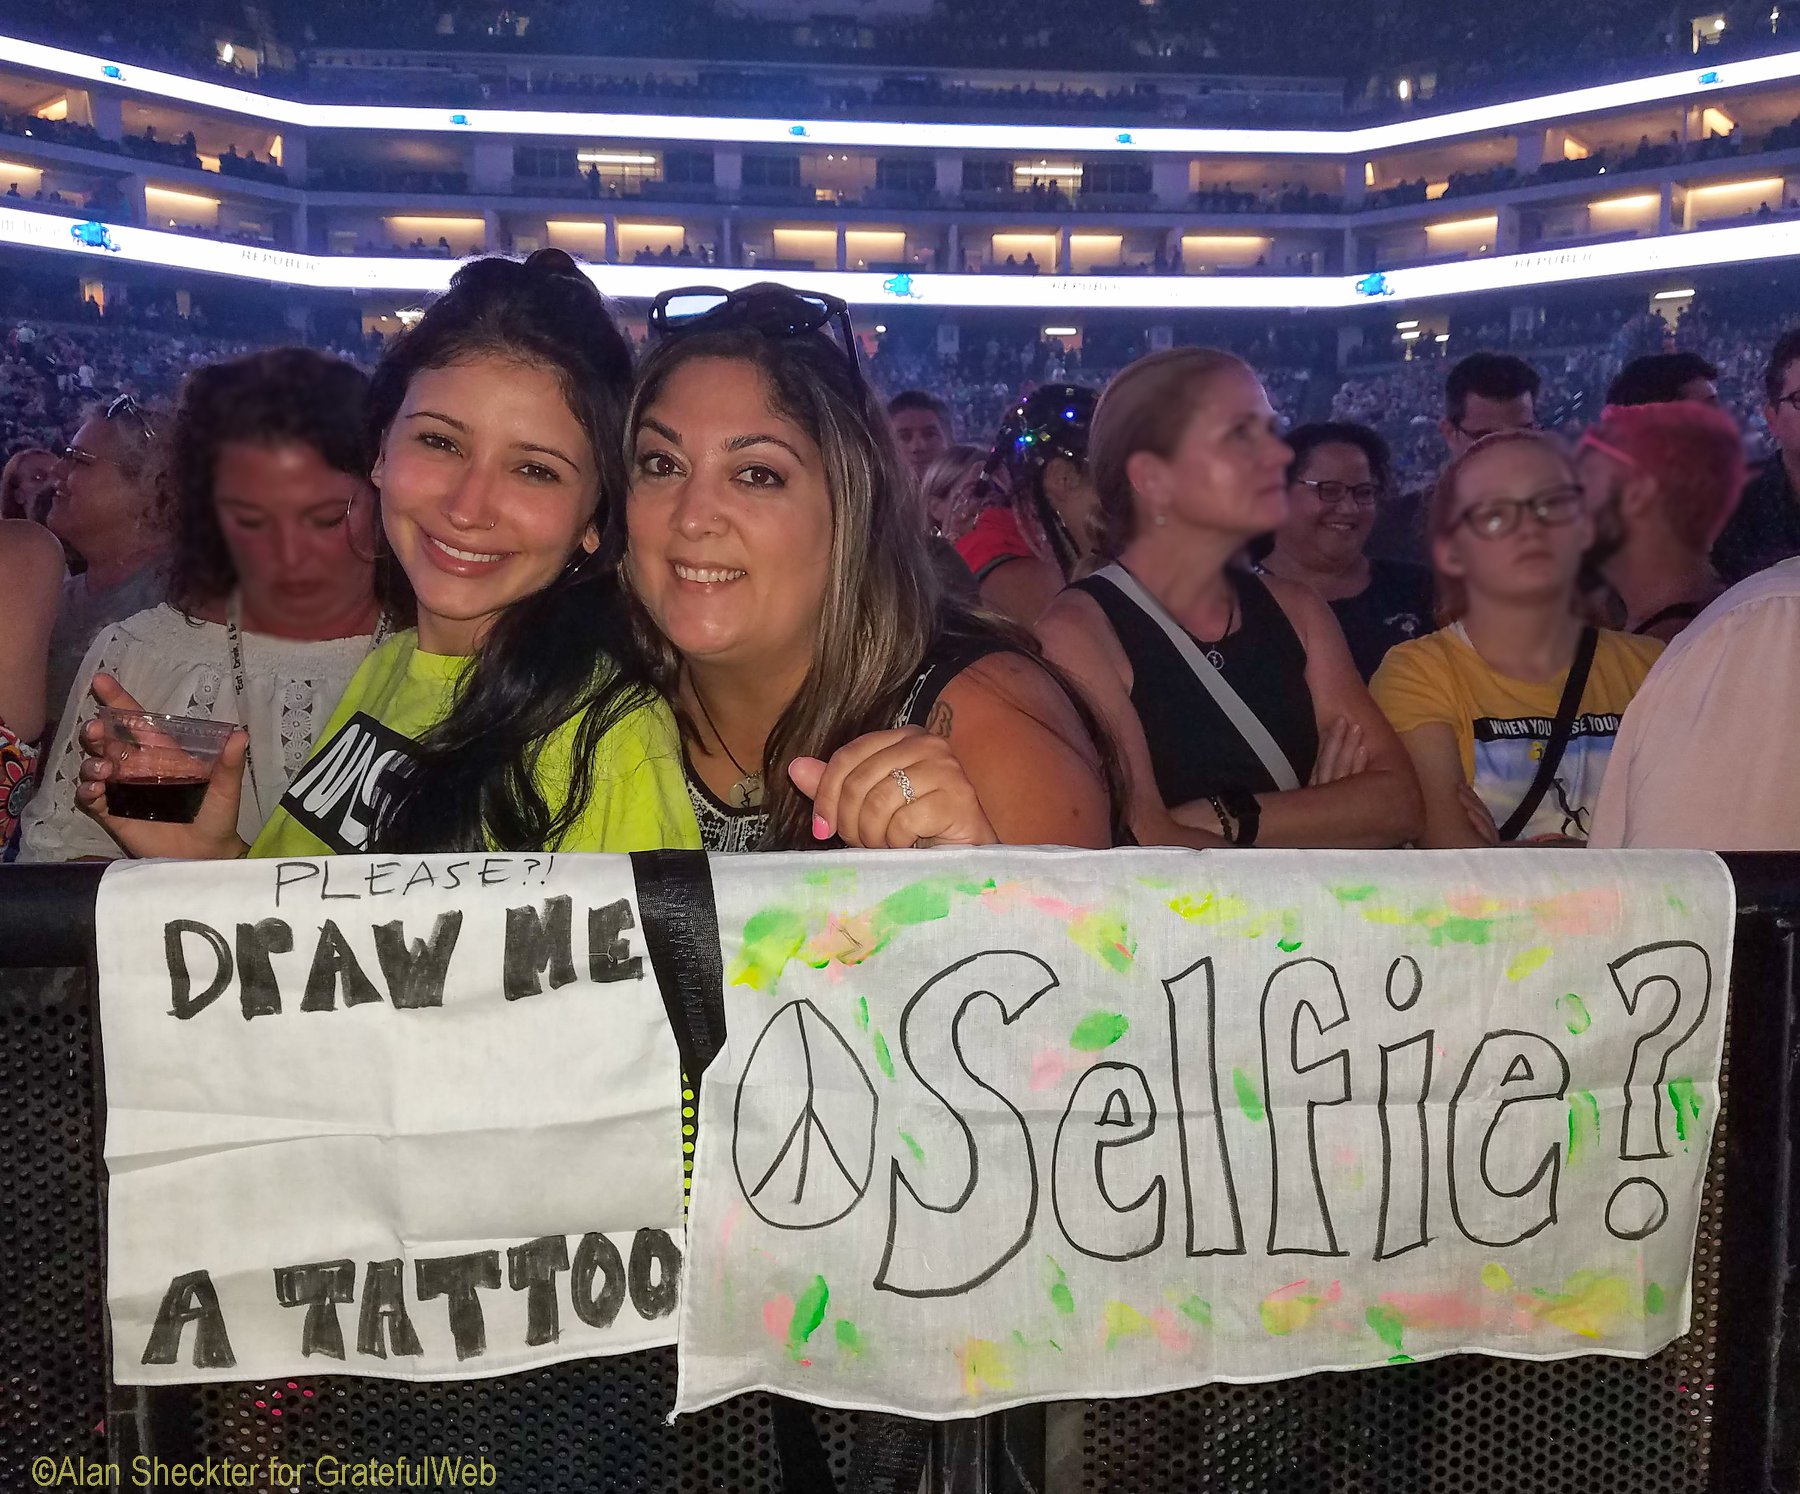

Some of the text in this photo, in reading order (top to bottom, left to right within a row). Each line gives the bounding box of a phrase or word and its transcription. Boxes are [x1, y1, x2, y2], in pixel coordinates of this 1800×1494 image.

[1489, 719, 1530, 736] WHEN
[1528, 718, 1553, 735] YOU
[275, 855, 554, 907] PLEASE?!
[502, 895, 644, 1001] ME
[873, 940, 1711, 1297] Selfie?
[140, 1227, 682, 1367] A TATTOO
